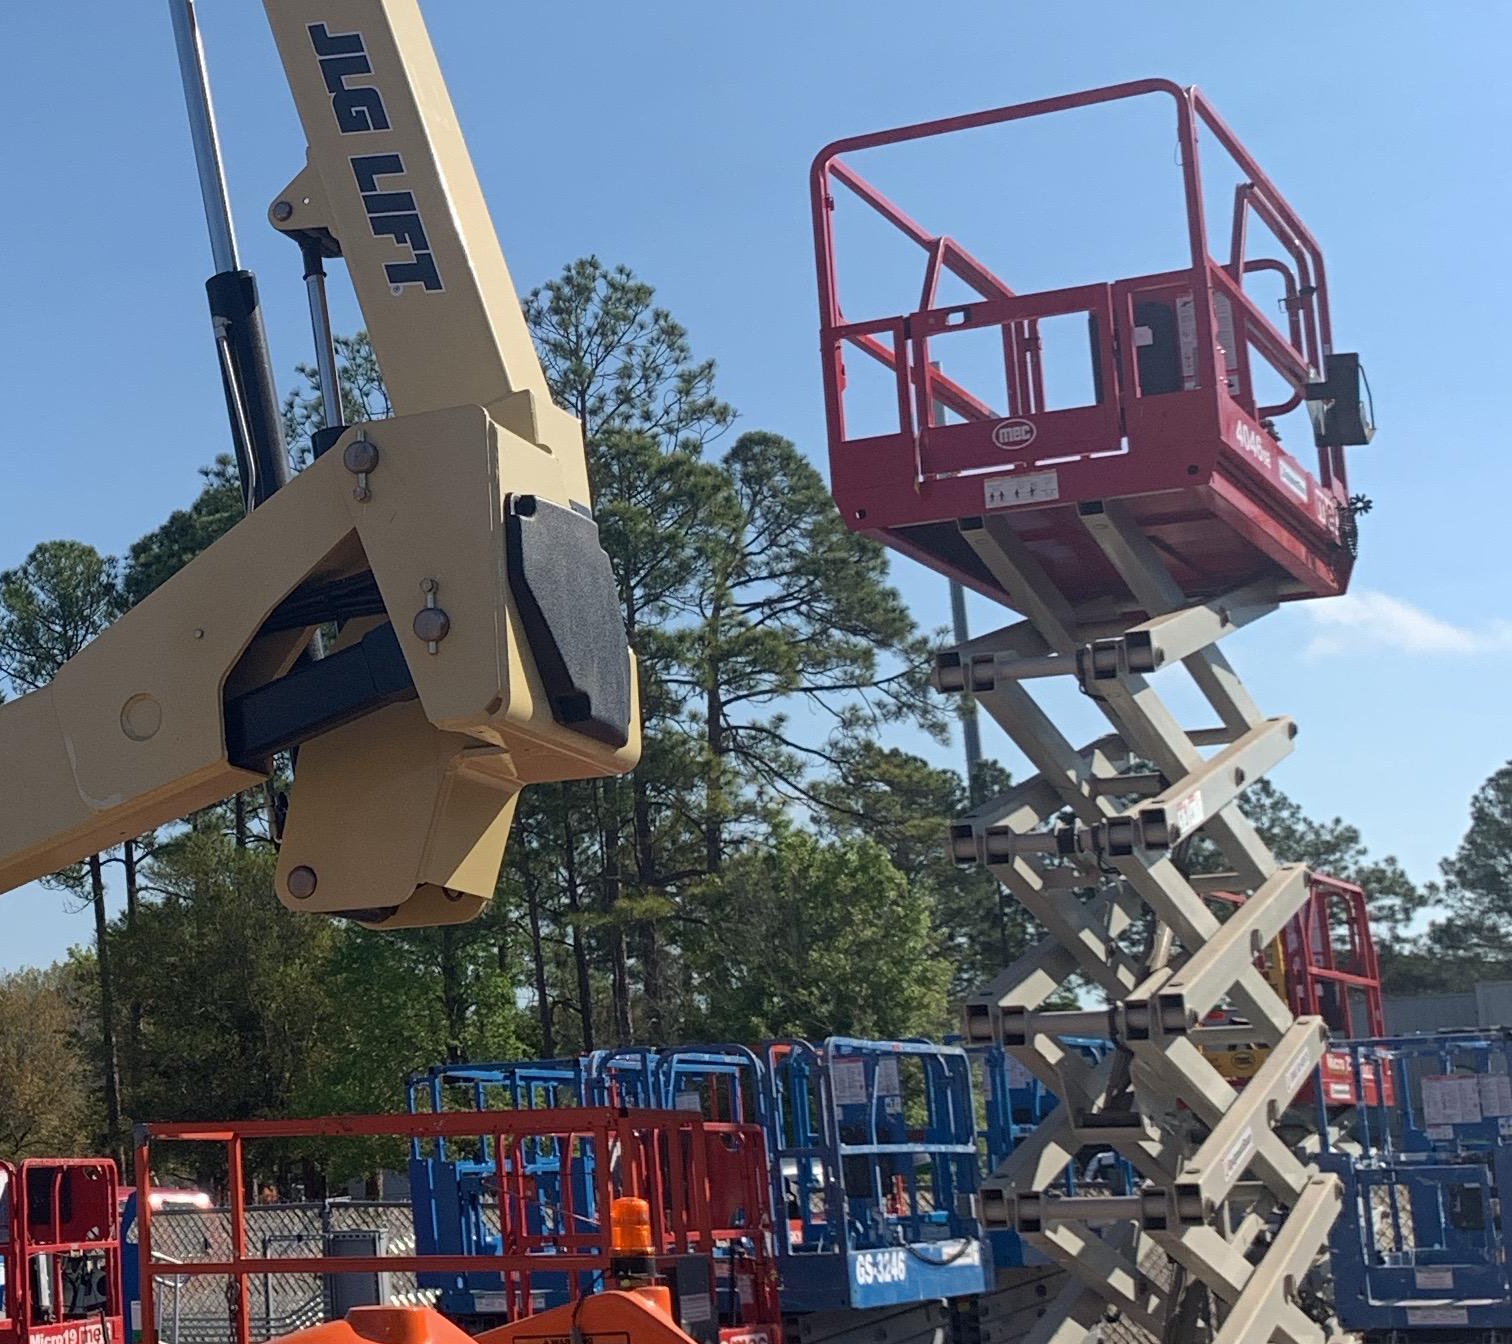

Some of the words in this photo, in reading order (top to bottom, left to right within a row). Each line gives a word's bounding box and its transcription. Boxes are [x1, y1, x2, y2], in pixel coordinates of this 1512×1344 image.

[304, 20, 393, 136] JLG
[347, 152, 446, 294] LIFT
[855, 1250, 907, 1286] GS-3246
